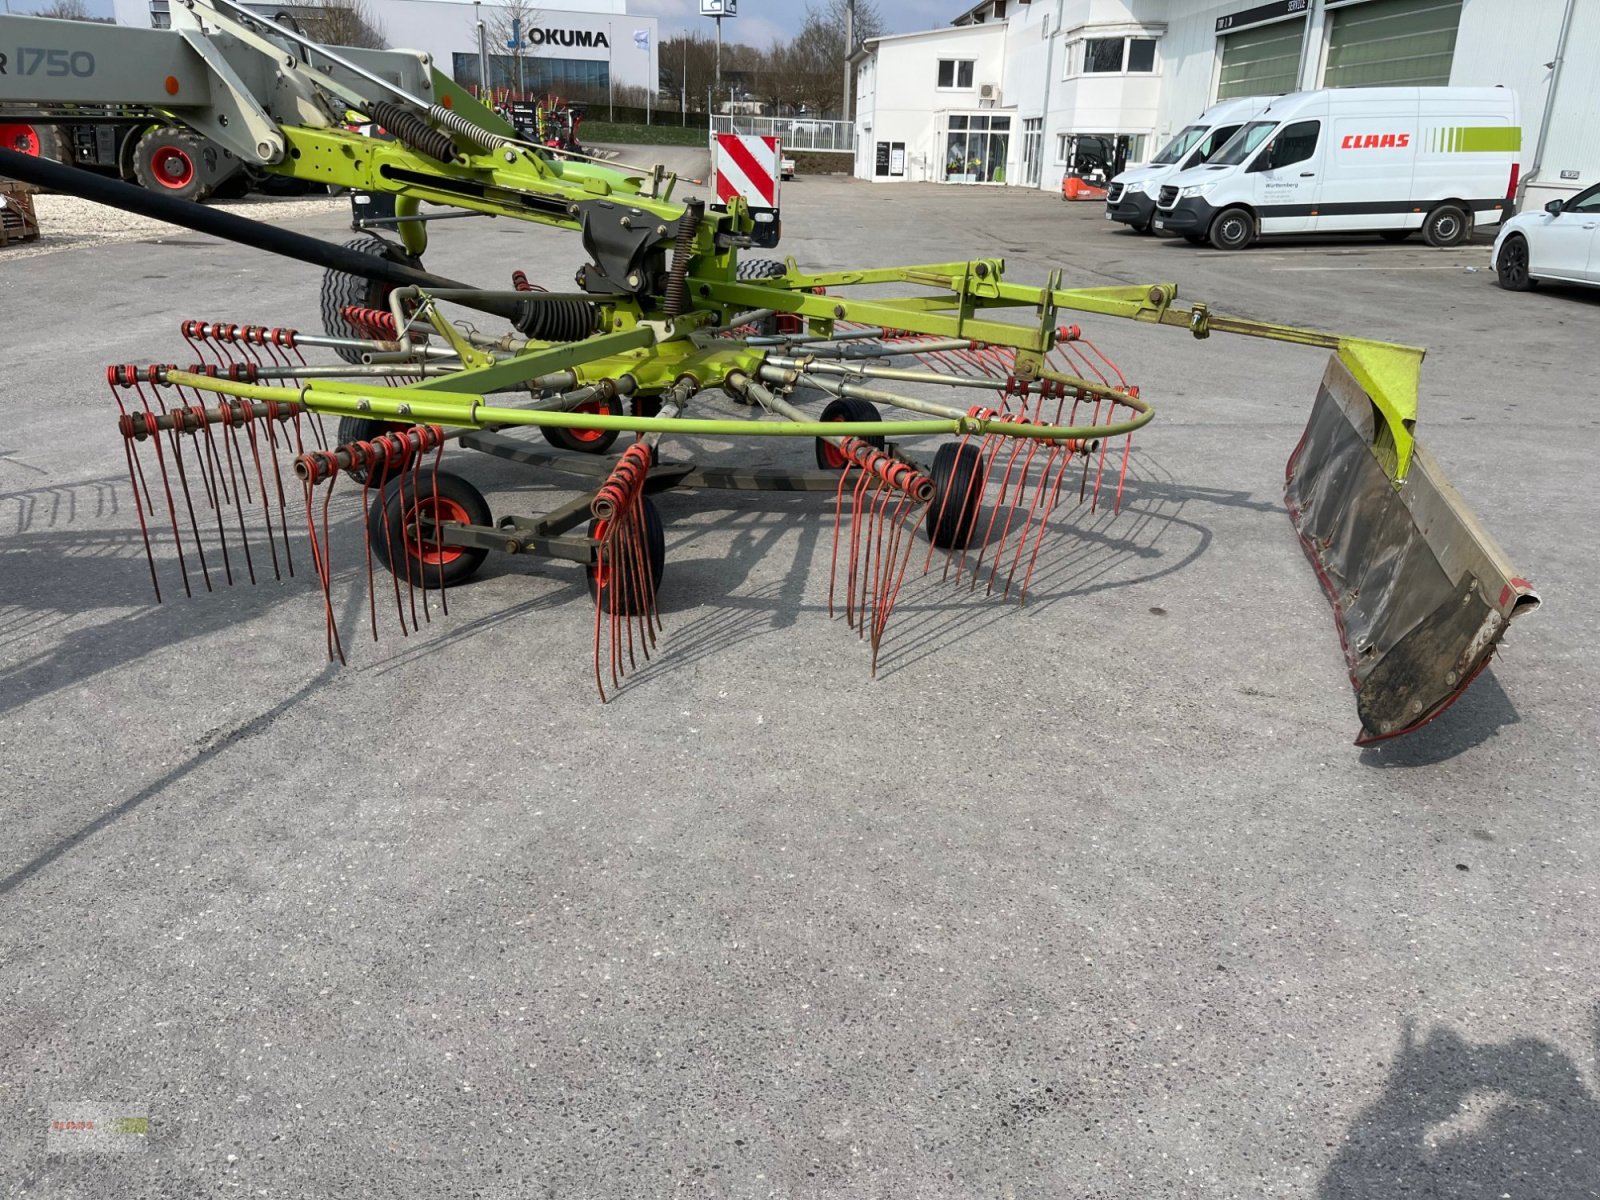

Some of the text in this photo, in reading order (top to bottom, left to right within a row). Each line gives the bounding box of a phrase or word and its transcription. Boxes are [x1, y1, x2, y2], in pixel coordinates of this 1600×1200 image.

[528, 27, 609, 48] OKUMA
[16, 47, 96, 78] 1750
[1341, 133, 1410, 149] CLAAS
